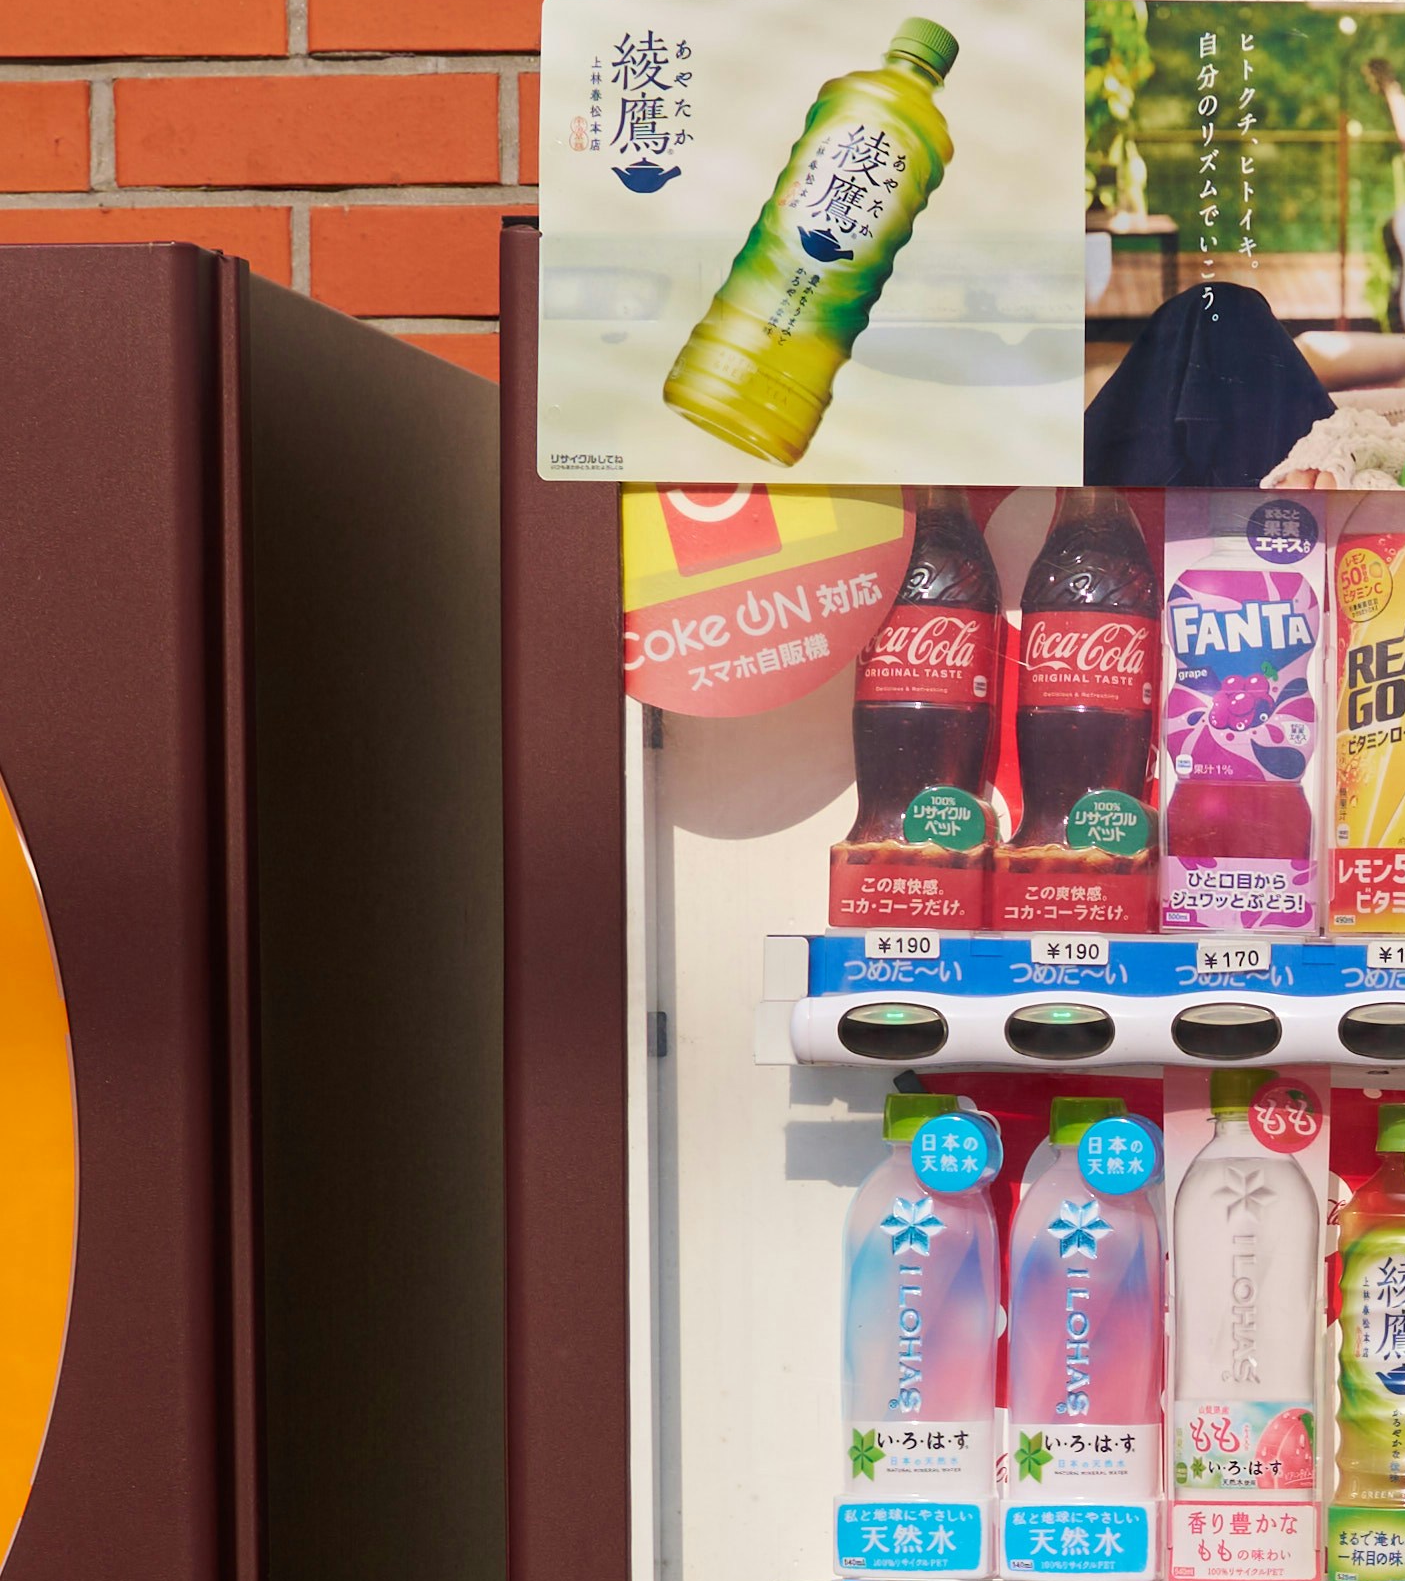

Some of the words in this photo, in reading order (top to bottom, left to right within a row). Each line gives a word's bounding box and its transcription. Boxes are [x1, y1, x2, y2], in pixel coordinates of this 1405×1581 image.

[611, 29, 671, 156] 綾鷹
[674, 39, 693, 146] あやたか
[590, 56, 603, 151] 上林春松本店
[1239, 31, 1262, 273] ヒトクチ、ヒトイキ。
[1198, 31, 1220, 326] 自分のリズムでいこう。
[551, 454, 623, 465] リサイクルしてね
[1173, 602, 1313, 654] FANTA
[1027, 619, 1144, 673] Coca-Cola
[688, 633, 830, 692] スマホ自販機
[1178, 667, 1208, 680] grape
[913, 806, 971, 821] リサイクル
[924, 820, 961, 836] ペット
[861, 877, 944, 894] この爽快感。
[1186, 872, 1286, 890] ひと口目から
[840, 898, 967, 916] コカ・コーラだけ。
[1171, 892, 1303, 911] ジュワッとぶどう!
[878, 936, 931, 954] ¥190
[1204, 950, 1260, 969] ¥170
[1189, 1513, 1298, 1536] 香り豊かな
[862, 1525, 956, 1554] 天然水
